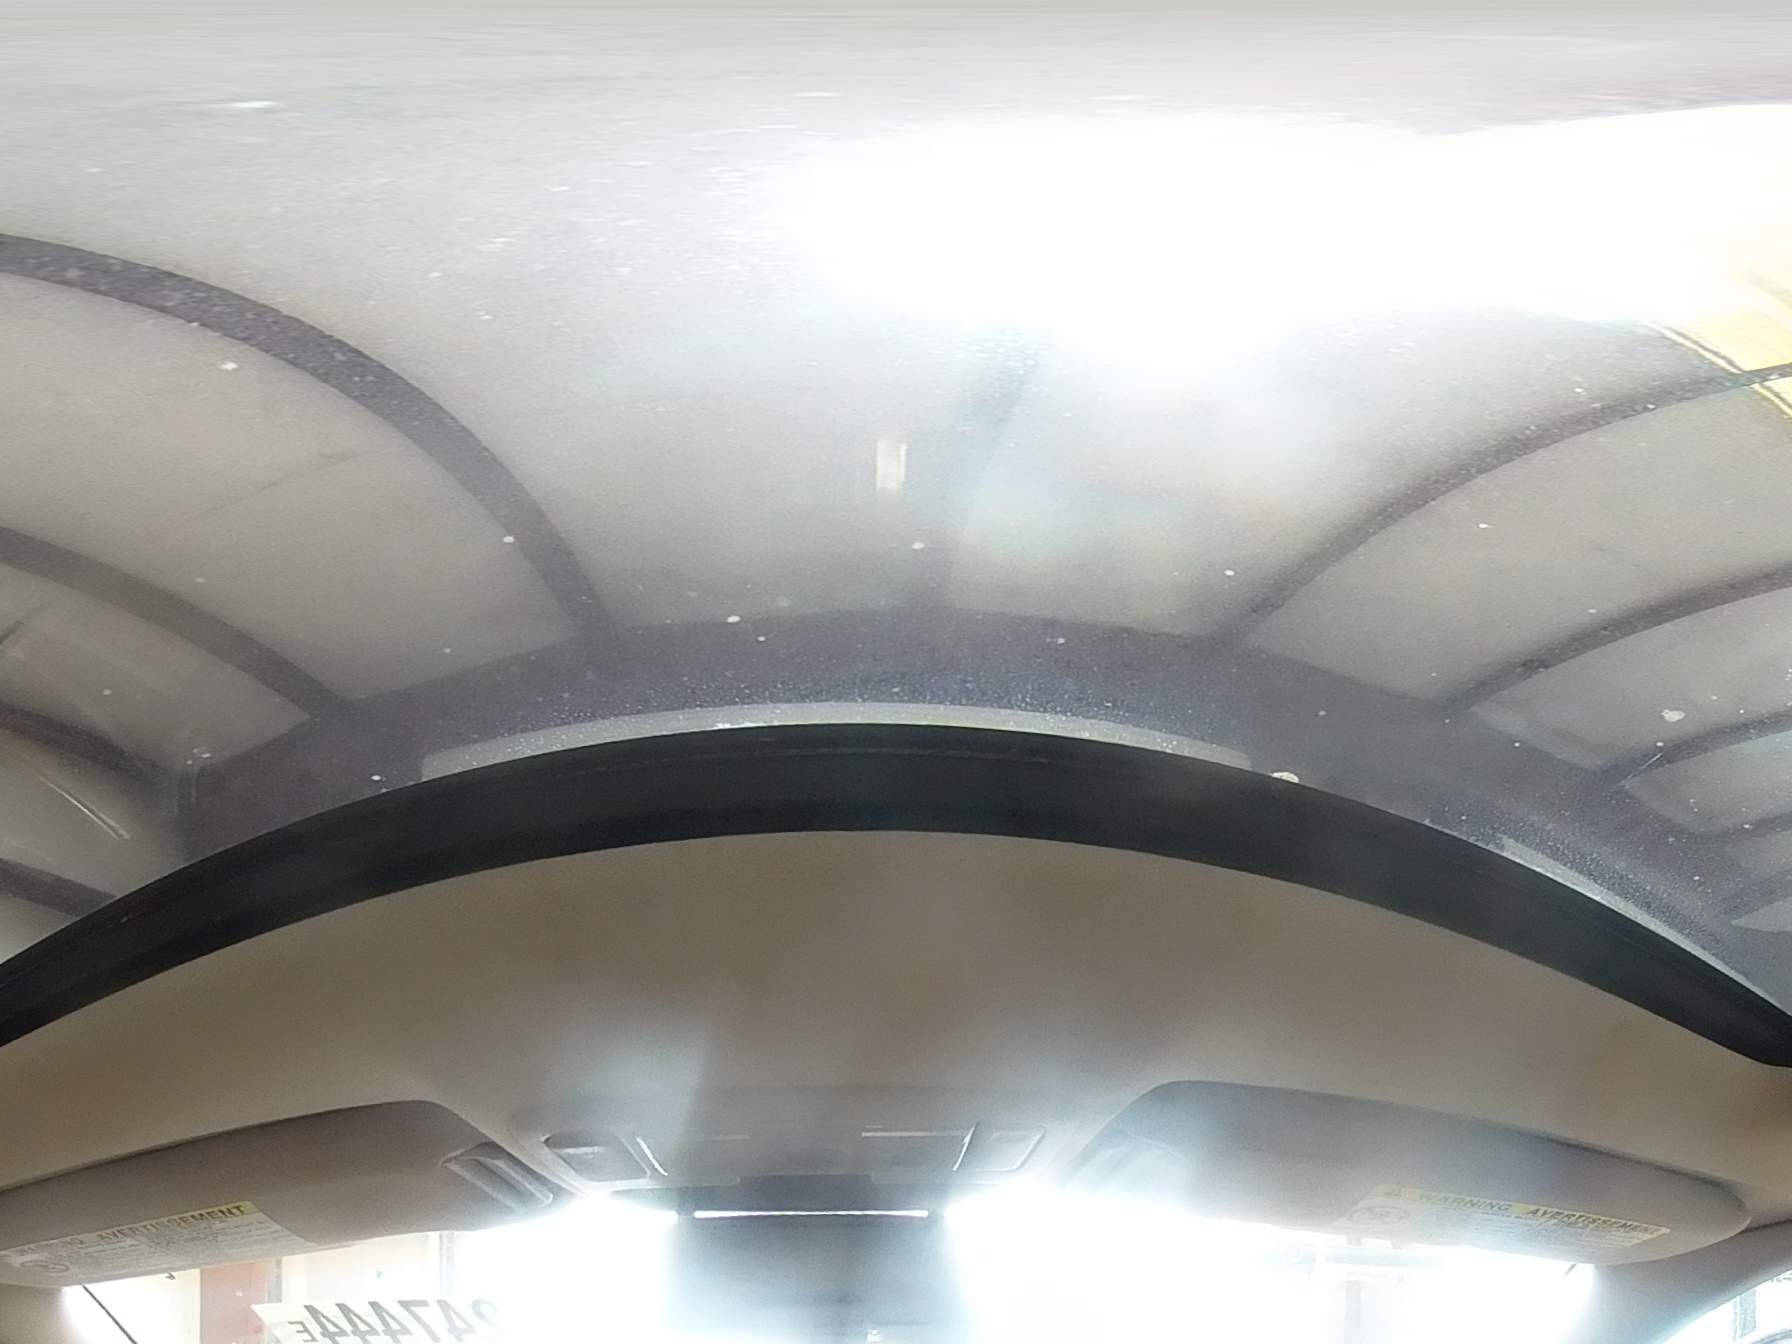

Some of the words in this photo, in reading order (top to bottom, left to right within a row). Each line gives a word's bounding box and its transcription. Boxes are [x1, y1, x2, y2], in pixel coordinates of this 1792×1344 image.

[97, 1205, 246, 1242] AVERTISSEMENT
[1421, 1191, 1512, 1212] WARNING
[1526, 1208, 1660, 1236] AVERTISSEMENT
